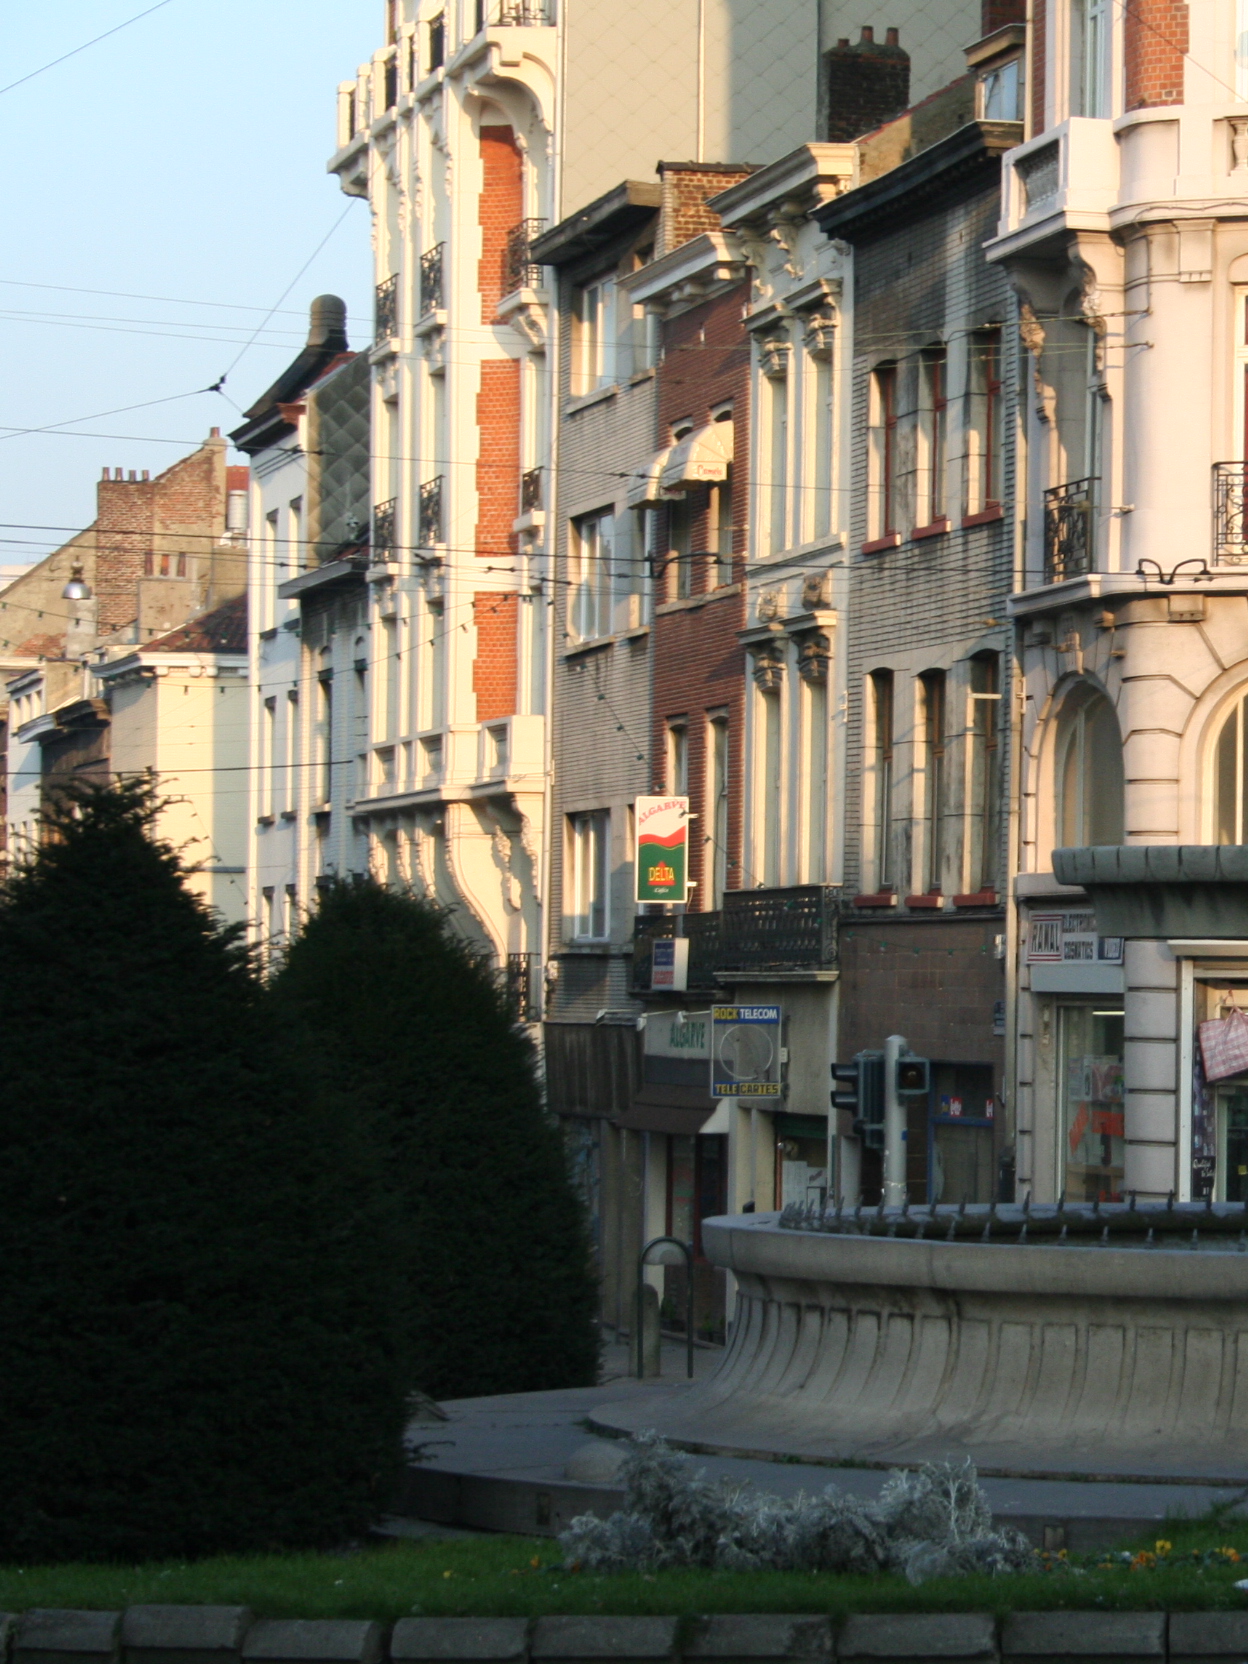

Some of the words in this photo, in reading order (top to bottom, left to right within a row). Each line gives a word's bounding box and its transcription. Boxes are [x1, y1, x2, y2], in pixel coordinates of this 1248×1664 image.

[639, 801, 686, 825] ALGARVE
[648, 866, 675, 881] DELTA
[1031, 923, 1060, 953] RAWAL
[714, 1008, 739, 1019] ROCK
[740, 1008, 778, 1019] TELECOM
[715, 1084, 738, 1095] TELE
[740, 1083, 778, 1095] CARTES
